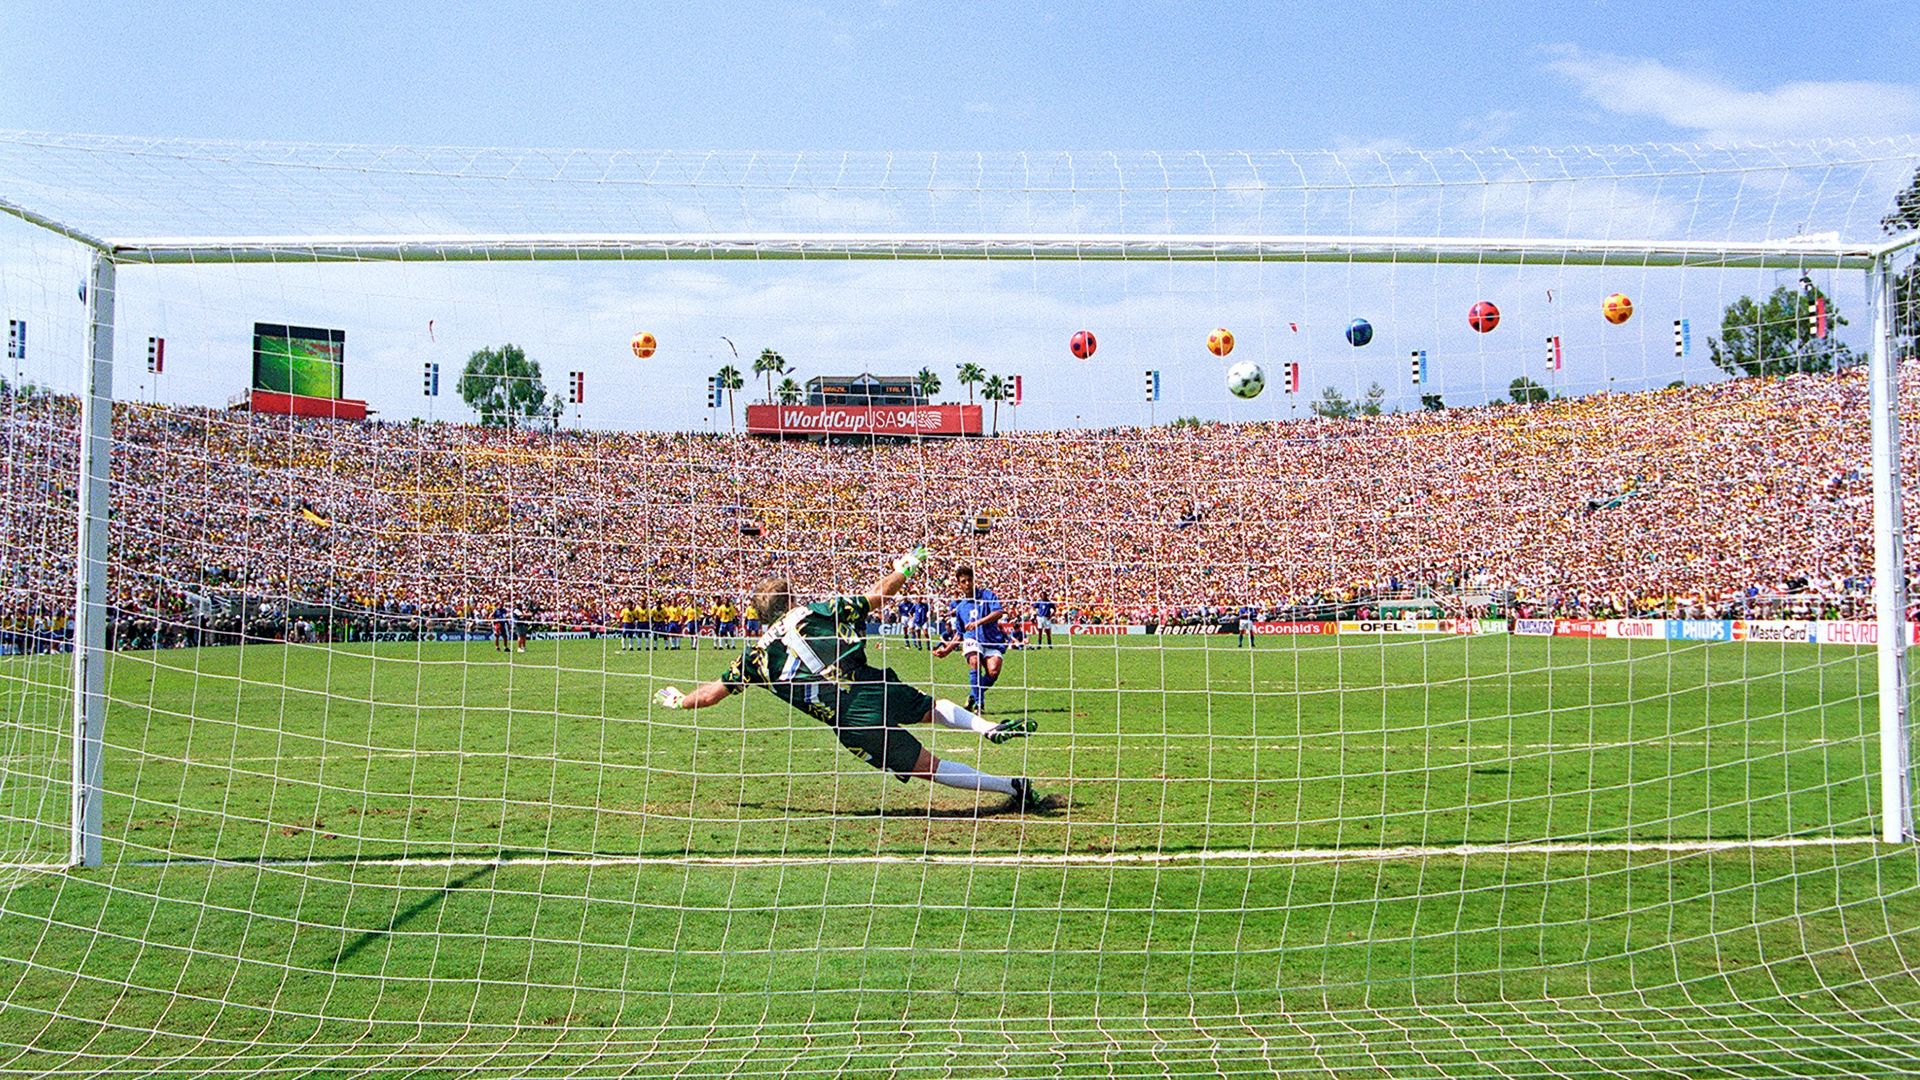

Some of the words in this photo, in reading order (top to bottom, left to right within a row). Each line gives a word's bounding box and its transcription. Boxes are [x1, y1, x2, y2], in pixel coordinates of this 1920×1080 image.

[1069, 624, 1128, 635] Canon
[1154, 623, 1222, 635] Energizer
[1253, 624, 1320, 634] cDonald's
[1360, 622, 1402, 632] OPEL
[1617, 621, 1653, 637] Canon
[1682, 620, 1725, 639] PHILIPS
[1750, 624, 1807, 641] MasterCard
